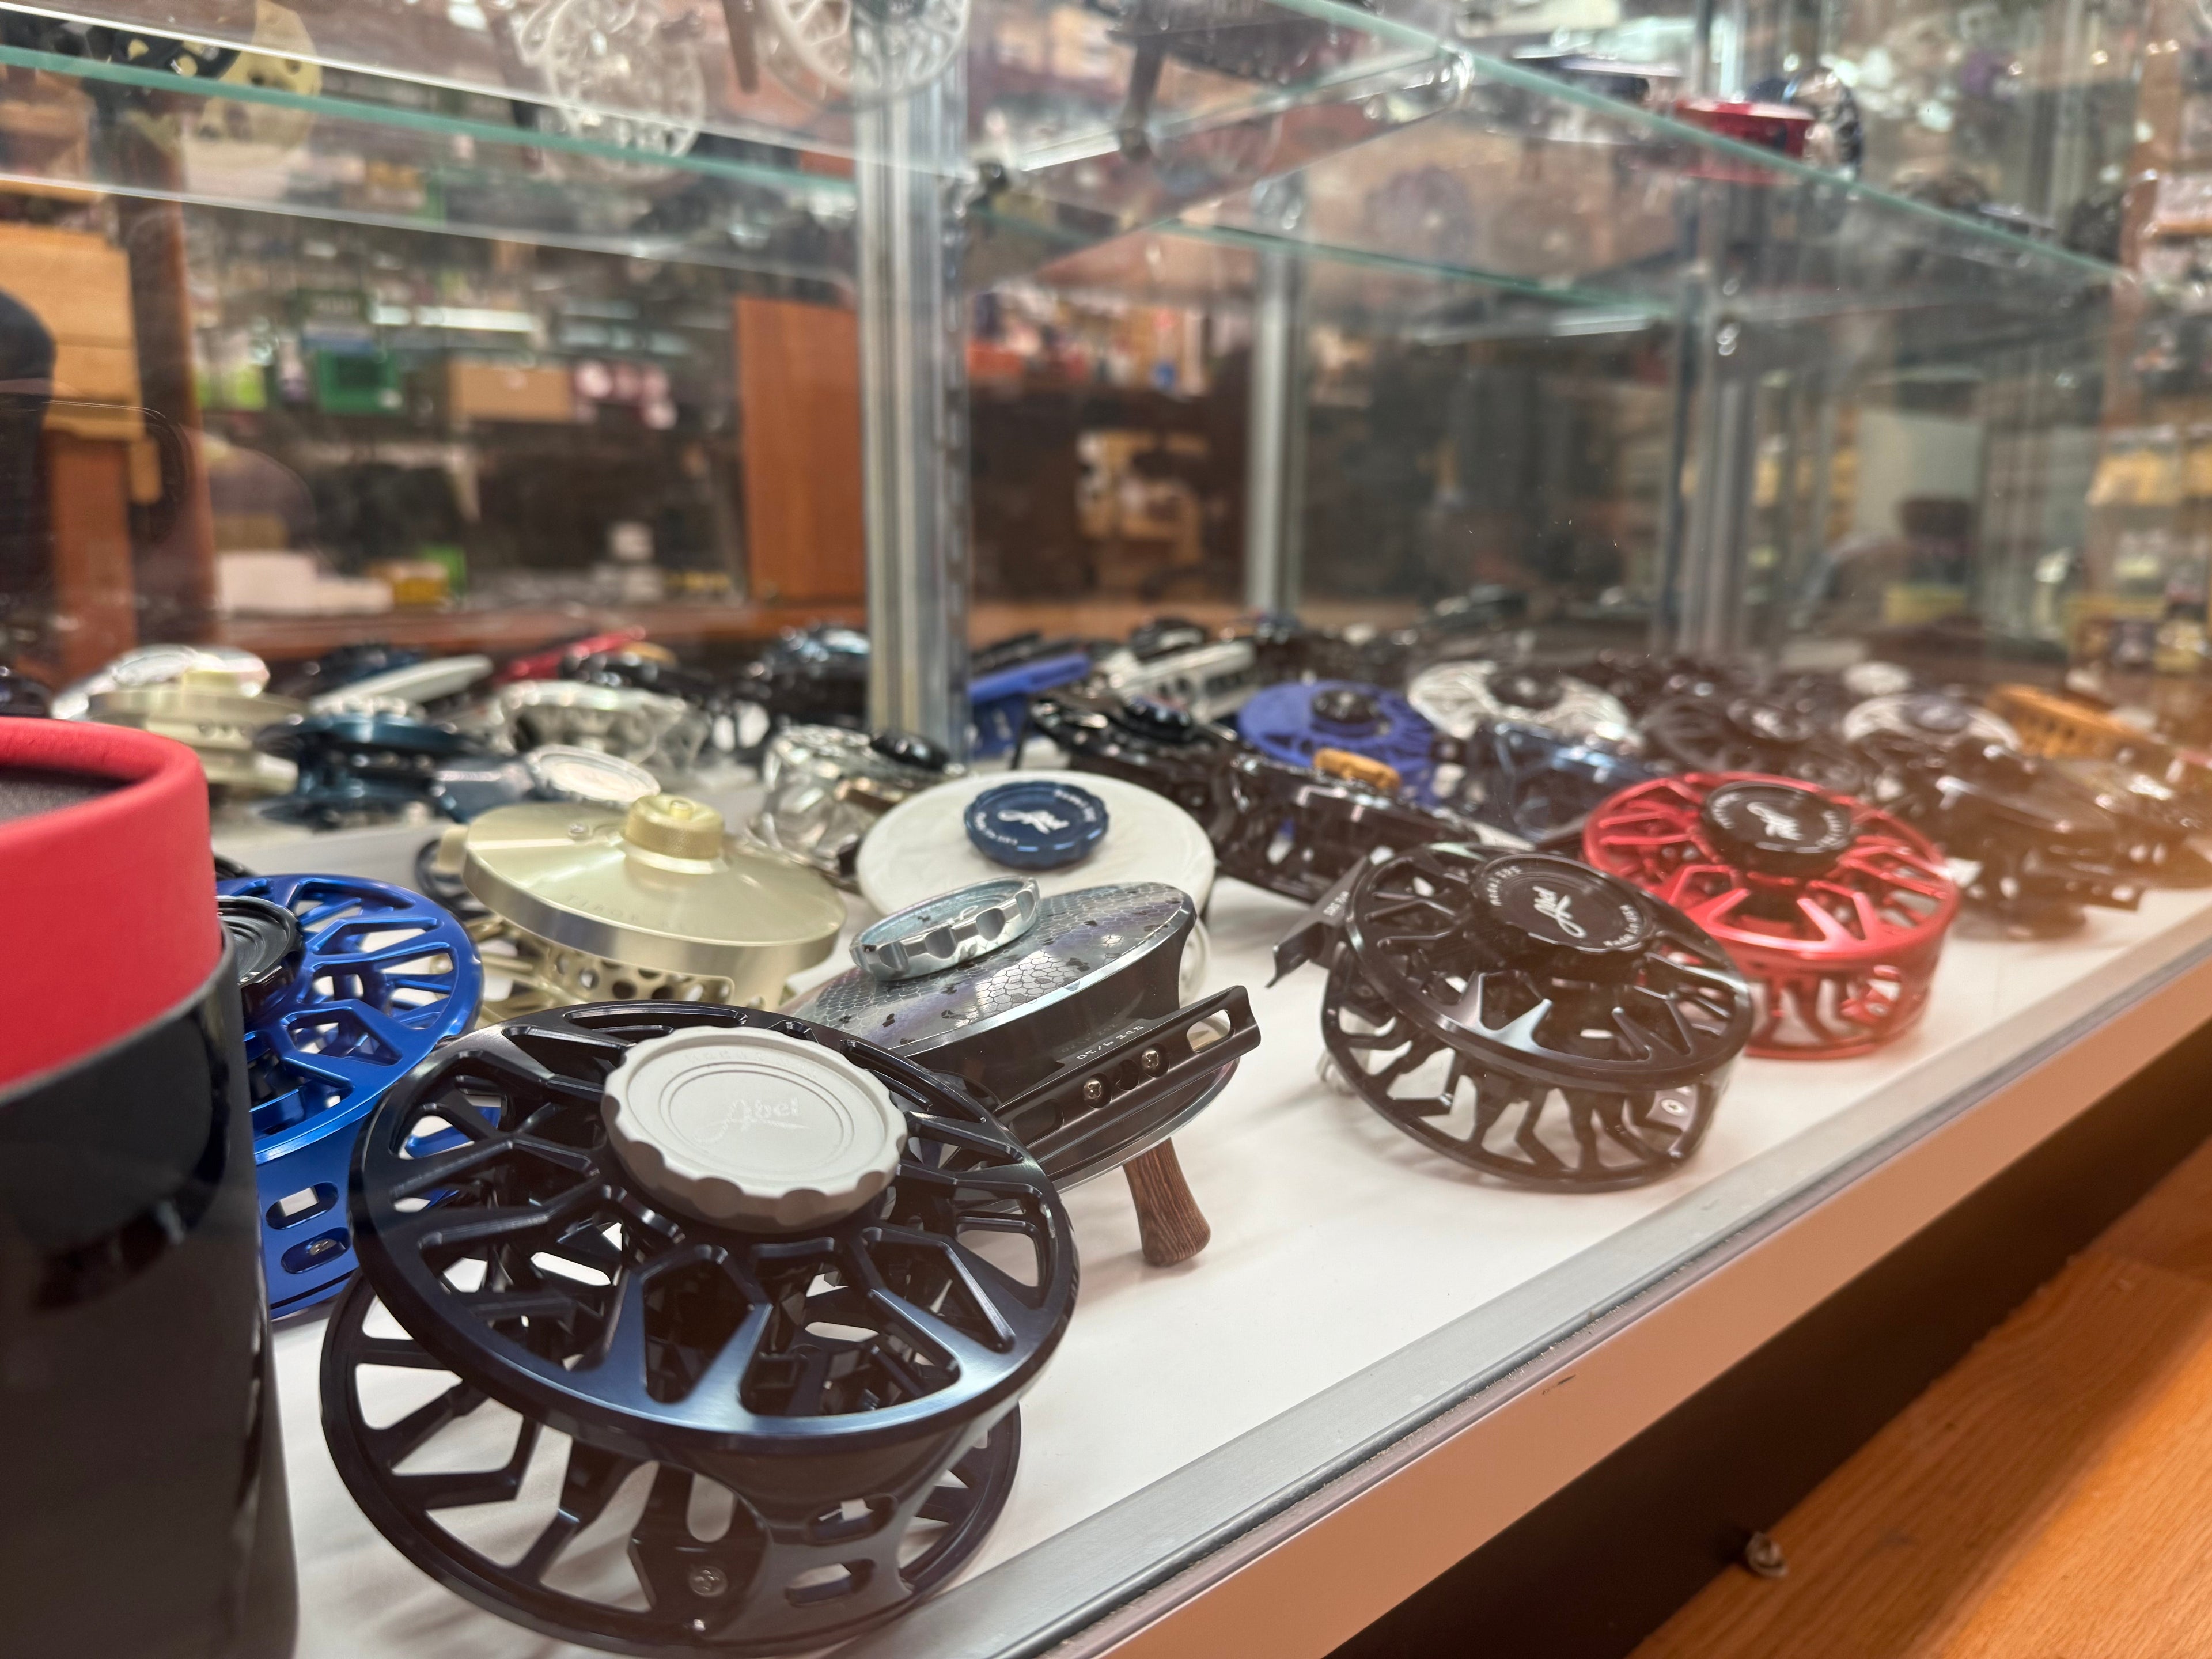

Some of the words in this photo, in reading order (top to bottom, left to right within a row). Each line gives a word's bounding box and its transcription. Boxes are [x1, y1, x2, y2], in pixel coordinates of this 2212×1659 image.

[1115, 1025, 1144, 1039] SDS
[1076, 1041, 1114, 1059] 9/10
[693, 1096, 809, 1144] Abel
